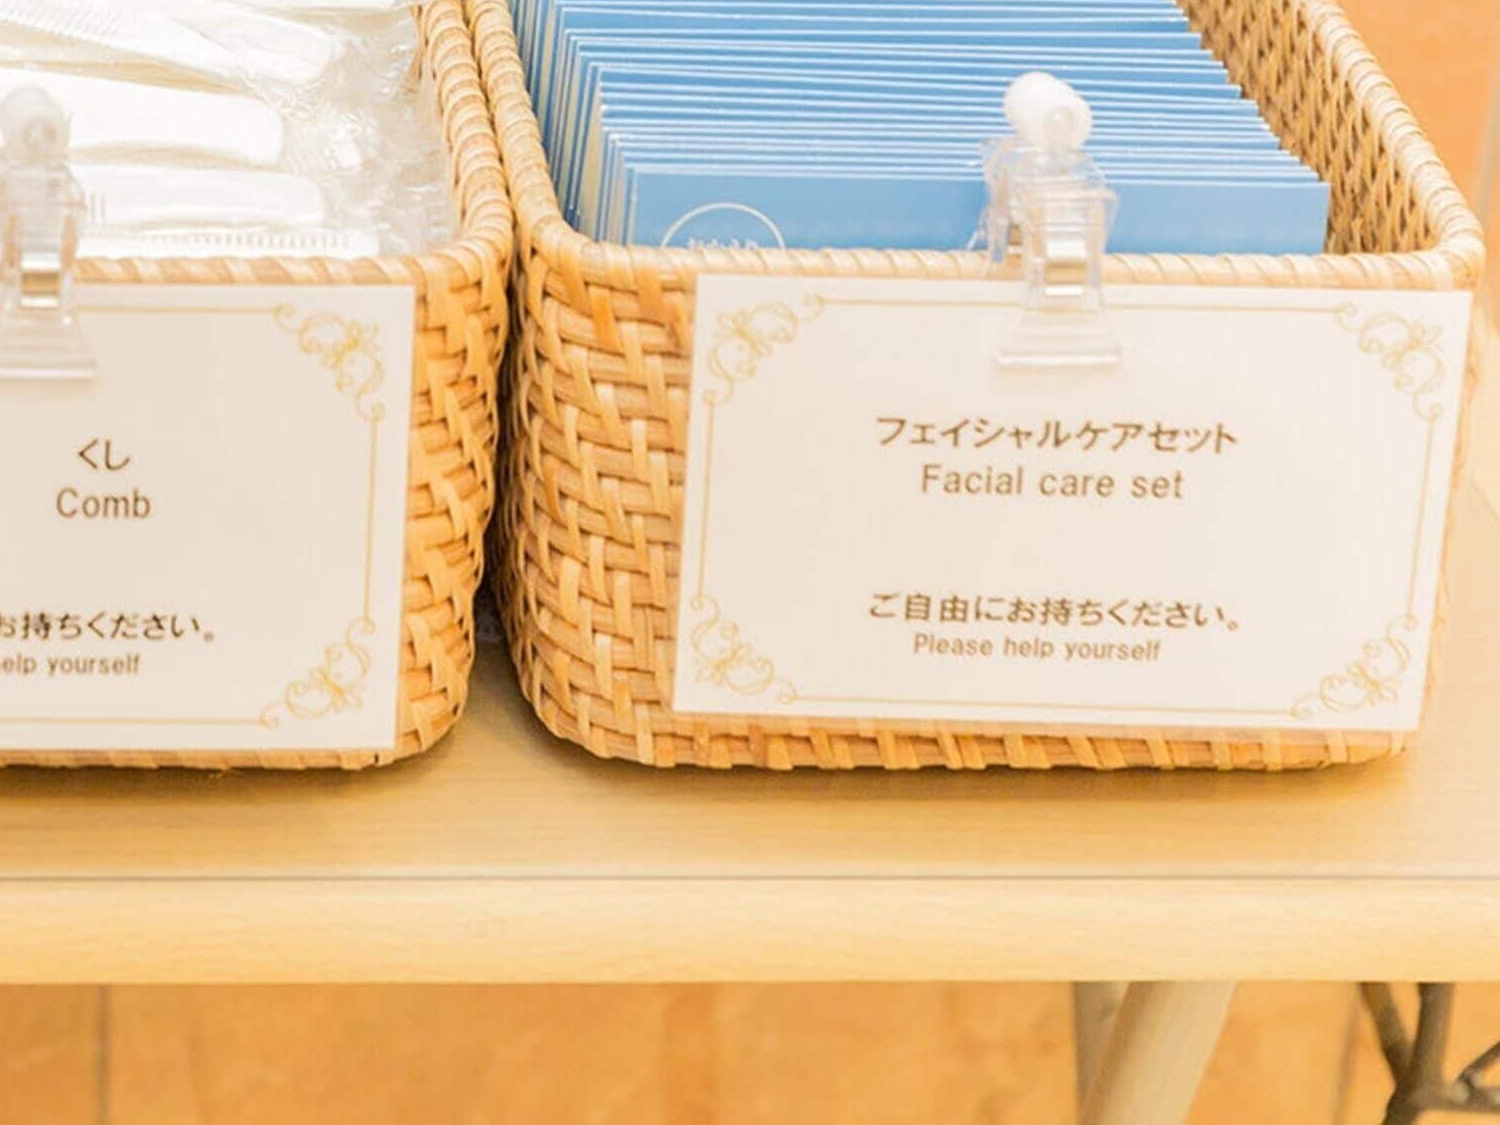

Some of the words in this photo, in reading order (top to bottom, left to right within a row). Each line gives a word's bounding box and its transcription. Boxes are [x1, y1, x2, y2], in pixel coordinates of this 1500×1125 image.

[875, 416, 1238, 455] フェイシャルケアセット
[76, 437, 132, 473] くし
[920, 462, 1024, 497] Facial
[1038, 473, 1116, 499] care
[1130, 469, 1184, 501] set
[55, 486, 152, 520] Comb
[868, 591, 1241, 632] ご自由にお持ちください。
[47, 651, 143, 678] yourself
[912, 632, 994, 658] Please
[1002, 635, 1055, 660] help
[1064, 638, 1162, 664] yourself
